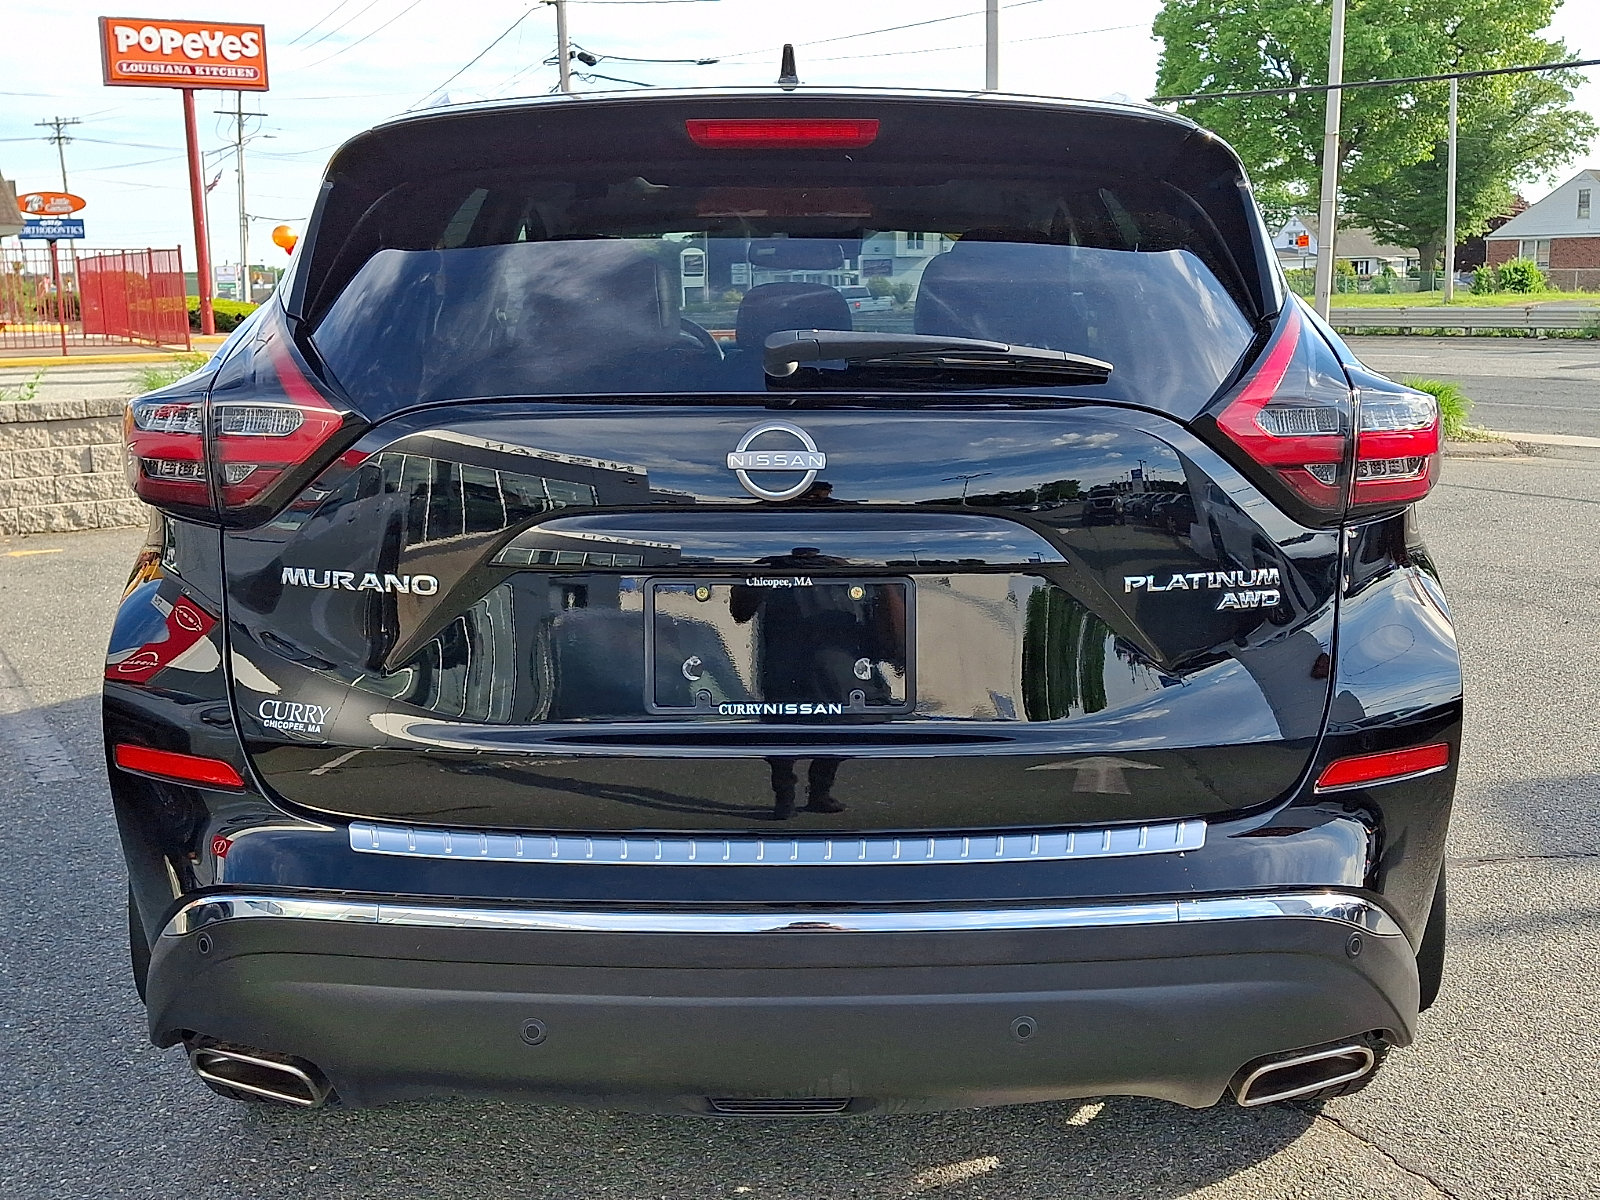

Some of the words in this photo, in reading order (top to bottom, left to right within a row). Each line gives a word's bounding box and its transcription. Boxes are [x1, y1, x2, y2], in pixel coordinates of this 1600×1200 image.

[121, 63, 192, 76] LOUISIANA
[194, 65, 255, 78] KITCHEN
[730, 454, 823, 467] NISSAN
[280, 566, 439, 597] MURANO
[746, 576, 793, 589] Chicopee,
[793, 576, 814, 587] MA
[1123, 567, 1281, 594] PLATINUM
[1215, 588, 1281, 611] AWD
[259, 700, 331, 724] CURRY
[263, 720, 306, 732] CHICOPEE,
[307, 724, 321, 733] MA
